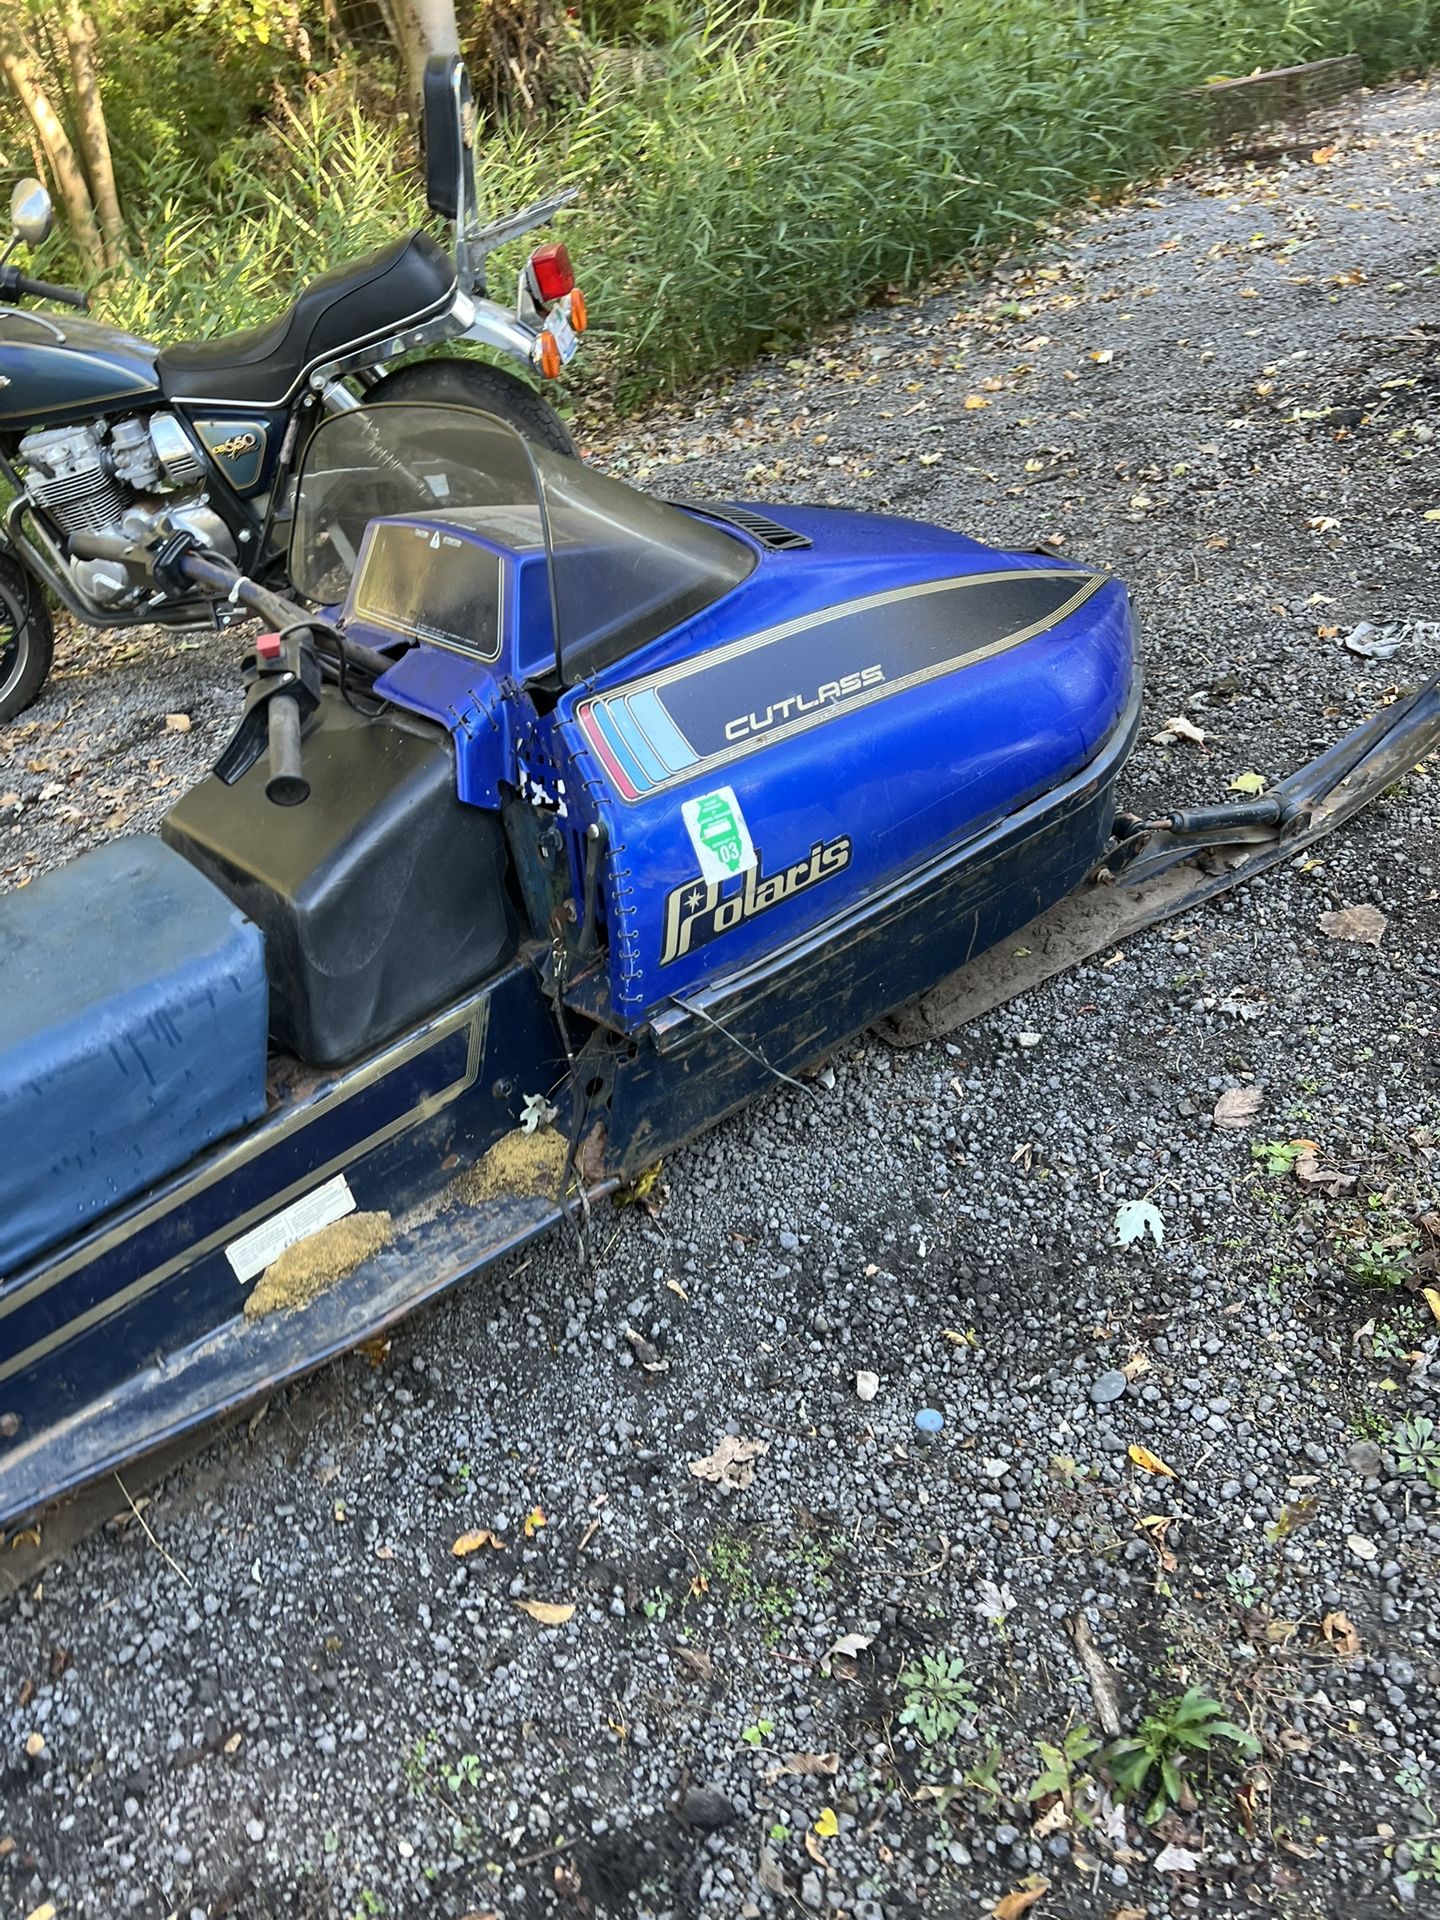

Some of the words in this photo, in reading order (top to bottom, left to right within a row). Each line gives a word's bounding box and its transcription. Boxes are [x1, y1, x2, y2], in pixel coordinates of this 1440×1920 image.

[724, 663, 886, 742] CUTLASS
[720, 841, 740, 863] 03
[660, 837, 850, 966] Polaris
